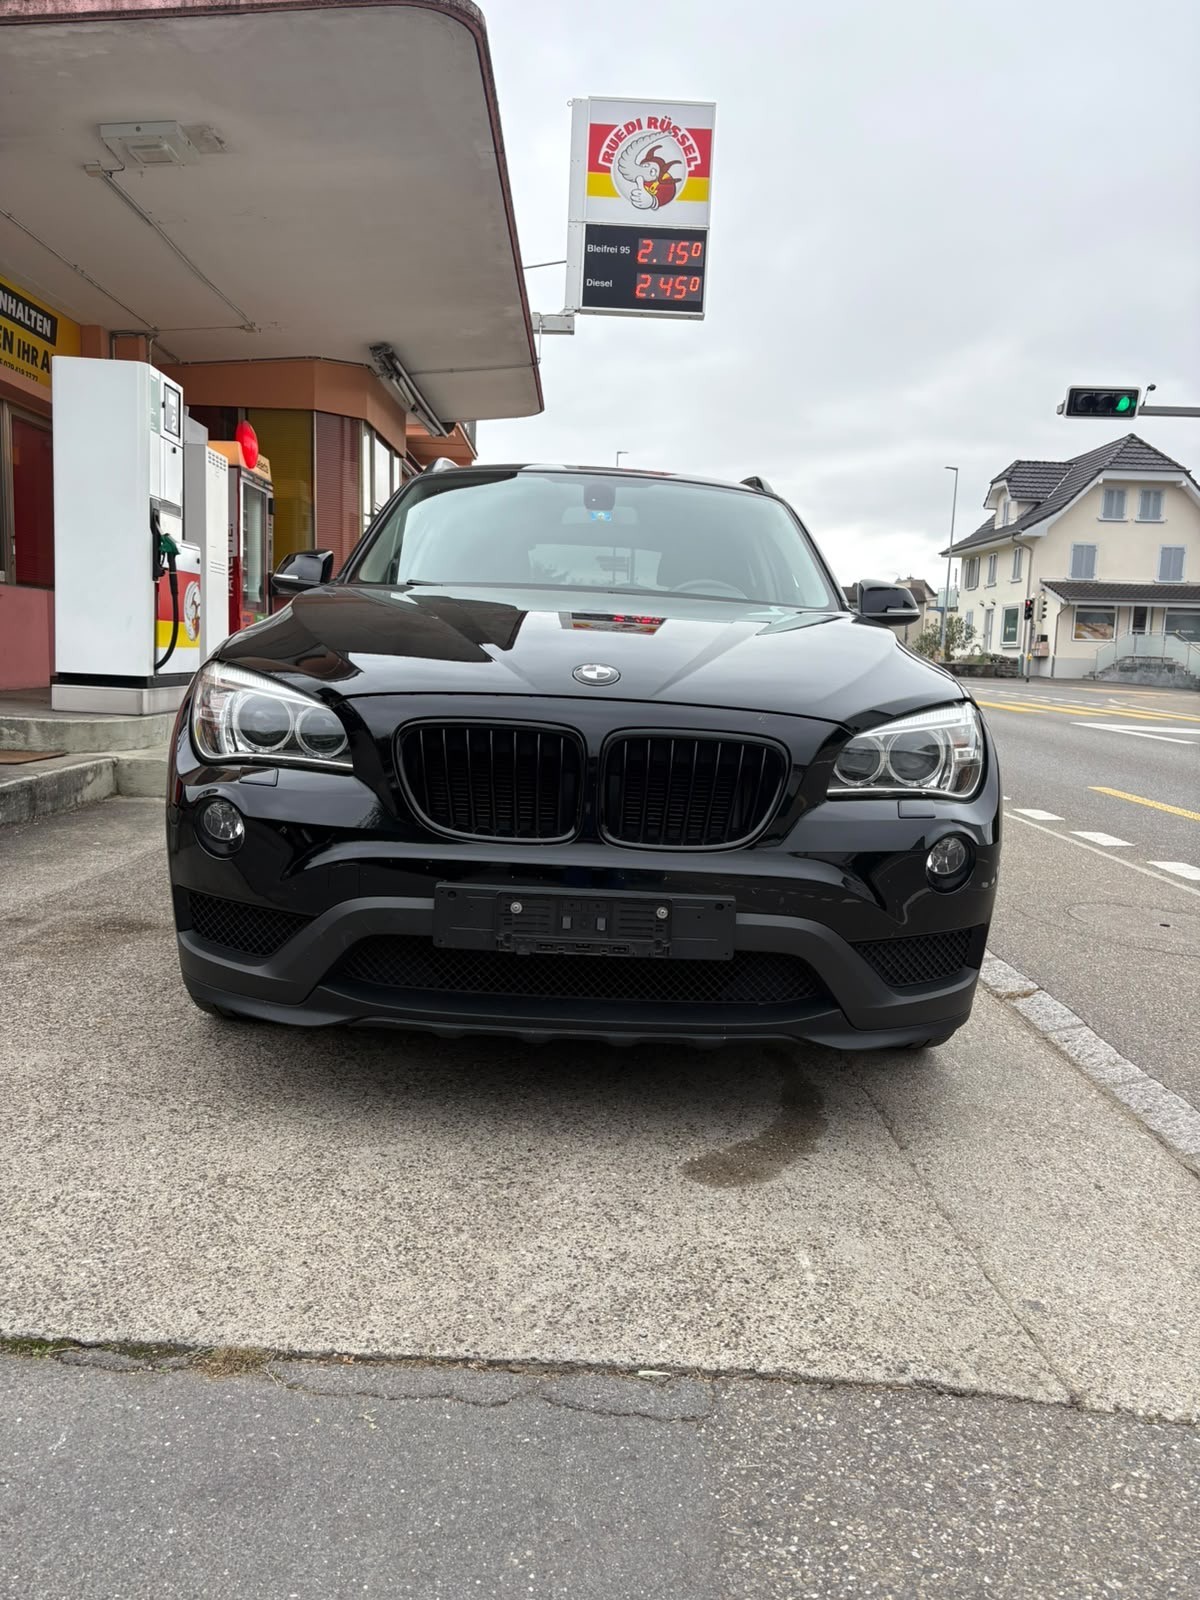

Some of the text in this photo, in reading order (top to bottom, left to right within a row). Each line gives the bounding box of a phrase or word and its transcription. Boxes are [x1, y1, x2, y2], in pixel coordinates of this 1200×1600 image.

[602, 115, 698, 168] RUEDI RÜSSEL
[587, 244, 618, 253] Bleifrei
[619, 246, 631, 255] 95
[586, 278, 613, 287] Diesel
[0, 325, 54, 374] N IHR A
